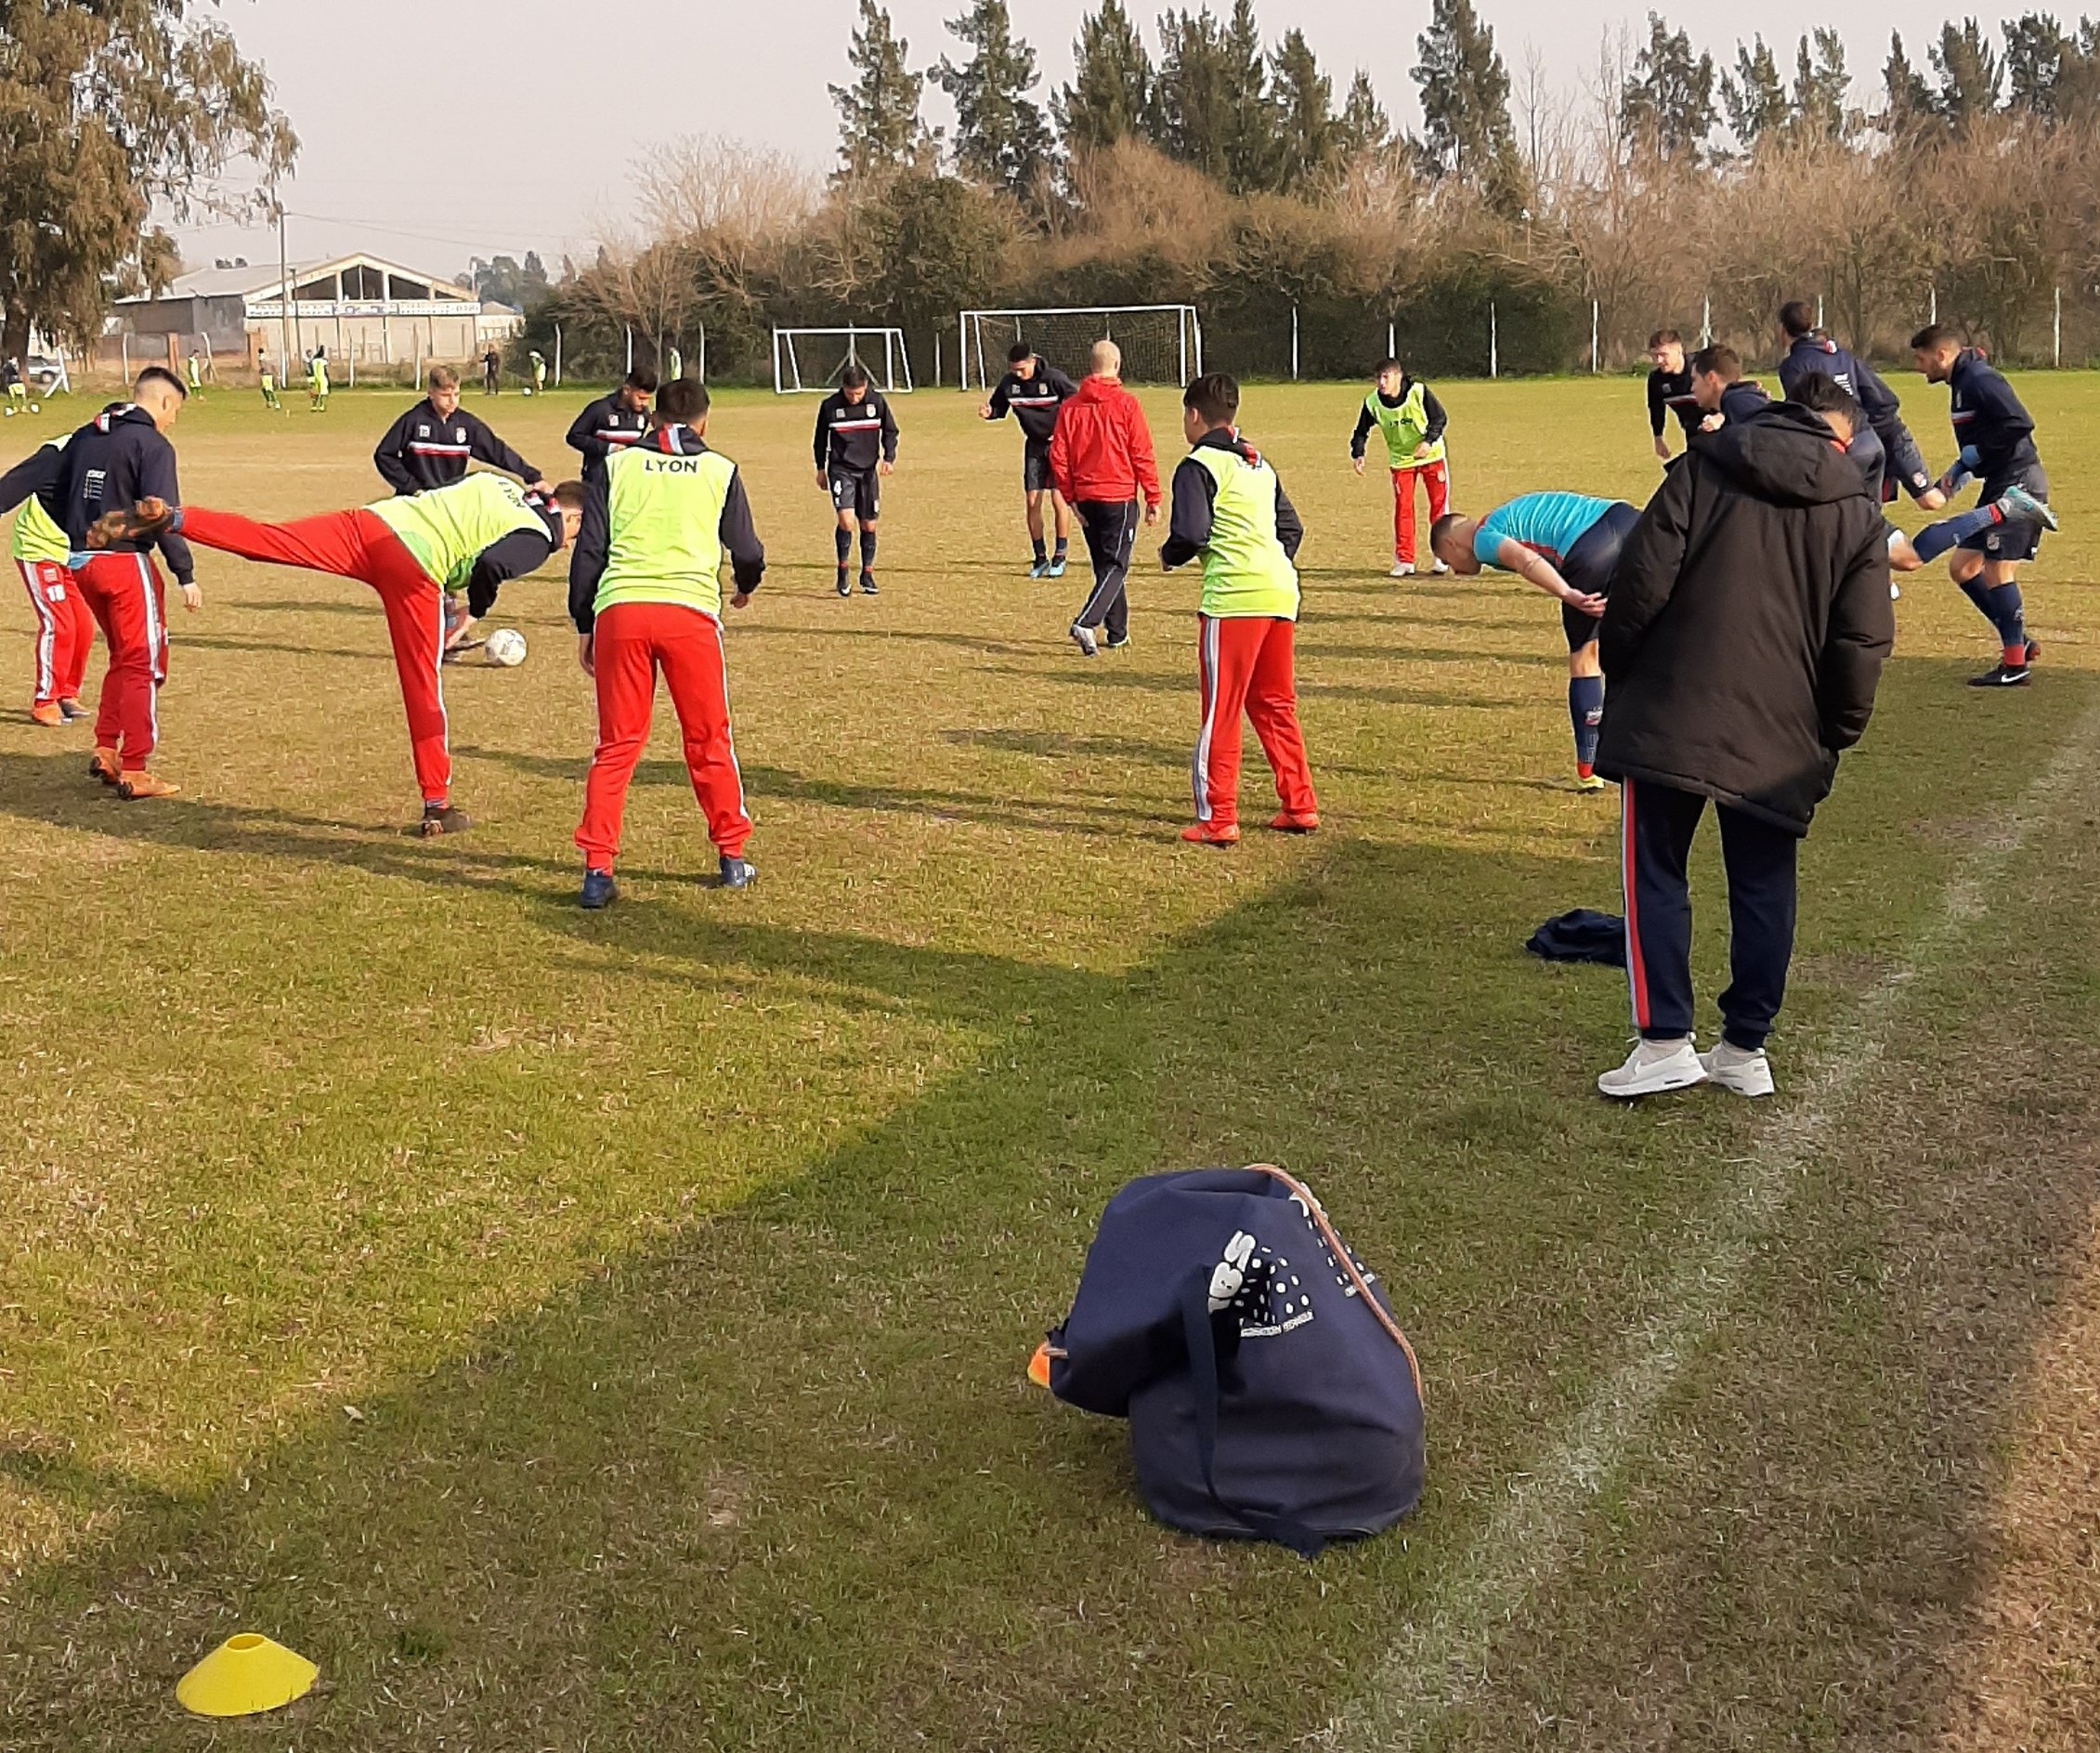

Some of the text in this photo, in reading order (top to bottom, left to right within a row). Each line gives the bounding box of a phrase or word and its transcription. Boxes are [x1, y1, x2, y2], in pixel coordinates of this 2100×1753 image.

[646, 459, 698, 473] LYON
[833, 479, 842, 496] 4
[46, 584, 66, 602] 18
